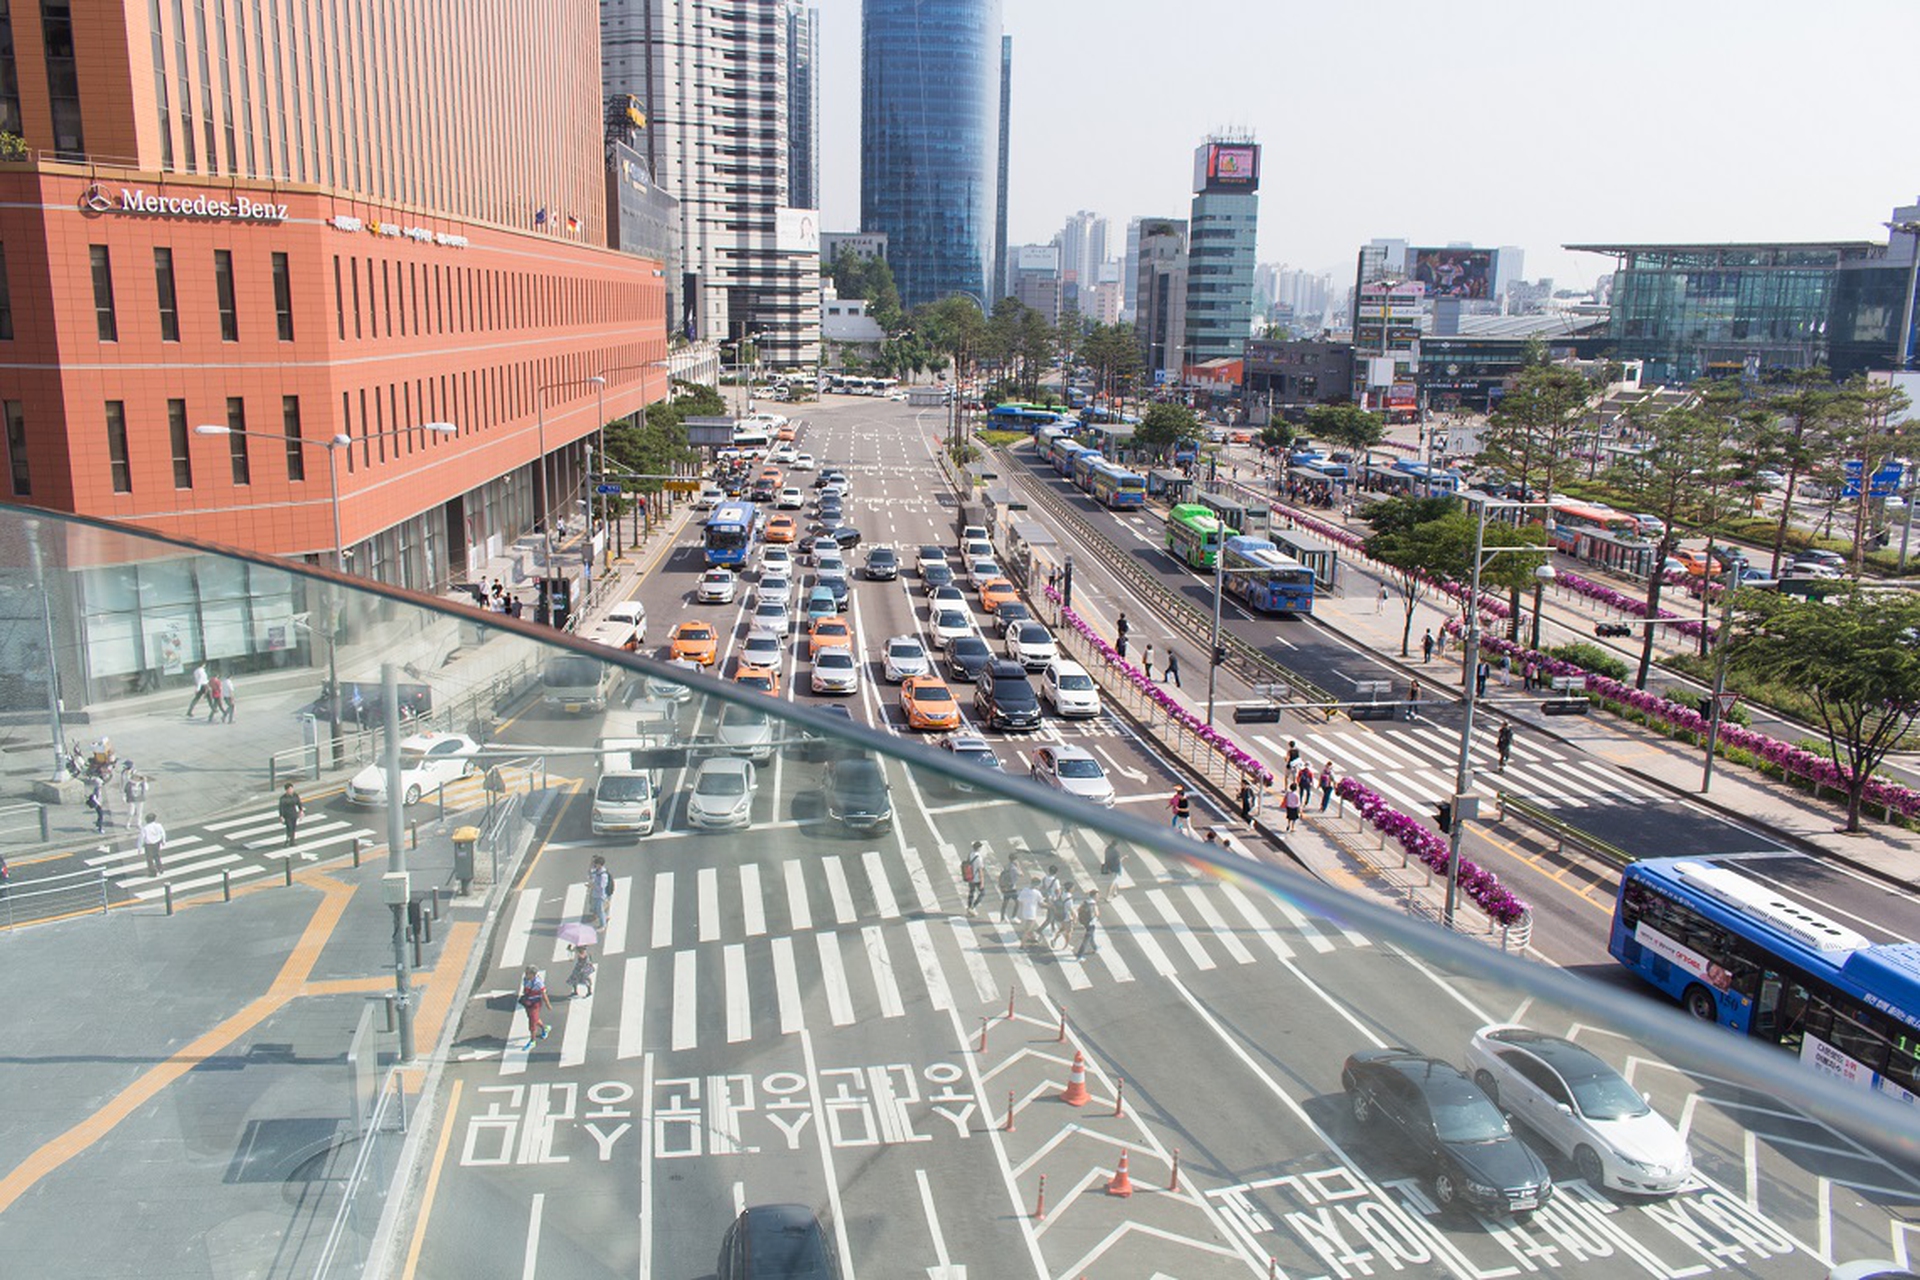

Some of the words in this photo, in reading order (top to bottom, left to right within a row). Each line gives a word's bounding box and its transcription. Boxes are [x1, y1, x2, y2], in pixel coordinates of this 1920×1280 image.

[121, 188, 289, 219] Mercedes-Benz
[1720, 992, 1739, 1011] 150
[460, 1081, 634, 1166] 숭례문
[655, 1072, 813, 1159] 숭례문
[820, 1063, 977, 1147] 숭례문
[1204, 1167, 1431, 1280] 염천교
